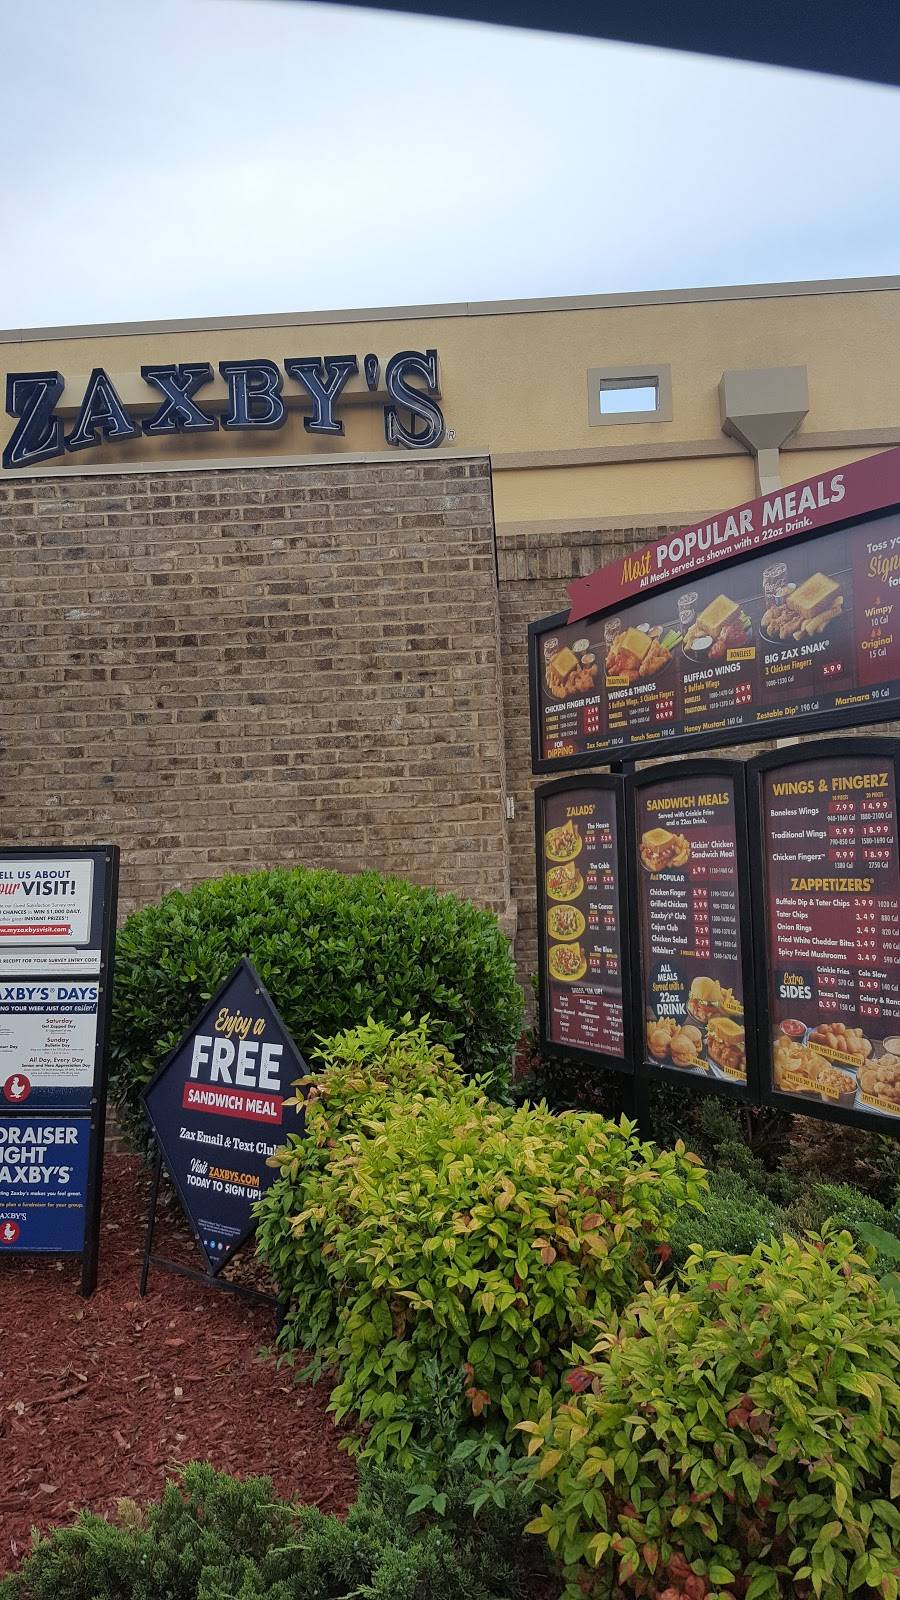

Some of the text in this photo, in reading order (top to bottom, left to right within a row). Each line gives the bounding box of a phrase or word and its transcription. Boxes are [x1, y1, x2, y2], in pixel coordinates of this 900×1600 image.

[621, 474, 846, 585] Most POPULAR MEALS
[640, 517, 813, 588] All Meals served as shown with a 22oz Drink.
[867, 541, 887, 553] Toss
[865, 604, 893, 617] Wimpy
[871, 617, 879, 627] 10
[862, 634, 893, 649] Original
[730, 650, 751, 659] BONELESS
[764, 654, 779, 664] BIG
[781, 649, 799, 661] ZAX
[869, 649, 877, 659] 15
[683, 662, 741, 684] BUFFALO WINGS
[765, 659, 813, 675] 3 Chicken Fingerz
[823, 663, 842, 674] 5.99
[608, 683, 656, 700] WINGS & THINGS
[835, 687, 890, 706] Marinara 90 Cal
[545, 695, 601, 714] CHICKEN FINGER PLATE
[757, 709, 783, 720] Zestable
[684, 718, 726, 733] Honey Mustard
[548, 745, 573, 759] DIPPING
[773, 773, 888, 796] WINGS & FINGERZ
[646, 793, 729, 811] SANDWICH MEALS
[658, 811, 673, 819] Served
[799, 807, 820, 816] Wings
[771, 831, 805, 839] Traditional
[806, 830, 827, 838] Wings
[772, 853, 797, 861] Chicken
[18, 871, 31, 879] US
[35, 870, 71, 879] ABOUT
[22, 880, 76, 896] VISIT!
[670, 889, 686, 897] Finger
[797, 899, 807, 907] Dip
[793, 911, 808, 919] Chips
[651, 923, 666, 931] Cajun
[796, 924, 812, 932] Rings
[672, 936, 687, 944] Salad
[811, 938, 839, 946] Cheddar
[839, 939, 855, 947] Bites
[778, 948, 793, 957] Spicy
[794, 949, 810, 957] Fried
[811, 950, 847, 960] Mushrooms
[660, 964, 671, 972] ALL
[657, 973, 678, 982] MEALS
[783, 972, 804, 985] Extra
[872, 971, 887, 979] Slaw
[57, 987, 98, 1001] DAYS
[660, 992, 679, 1002] 22oz
[780, 986, 812, 999] SIDES
[818, 990, 834, 998] Texas
[859, 995, 878, 1004] Celery
[657, 1003, 687, 1015] DRINK
[215, 1007, 265, 1040] Enjoy a
[190, 1035, 283, 1091] FREE
[188, 1089, 277, 1116] SANDWICH MEAL
[179, 1127, 255, 1153] Zax Email & Text
[190, 1158, 260, 1187] Visit ZAXBYS.COM
[187, 1174, 261, 1201] TODAY TO SIGN UP!
